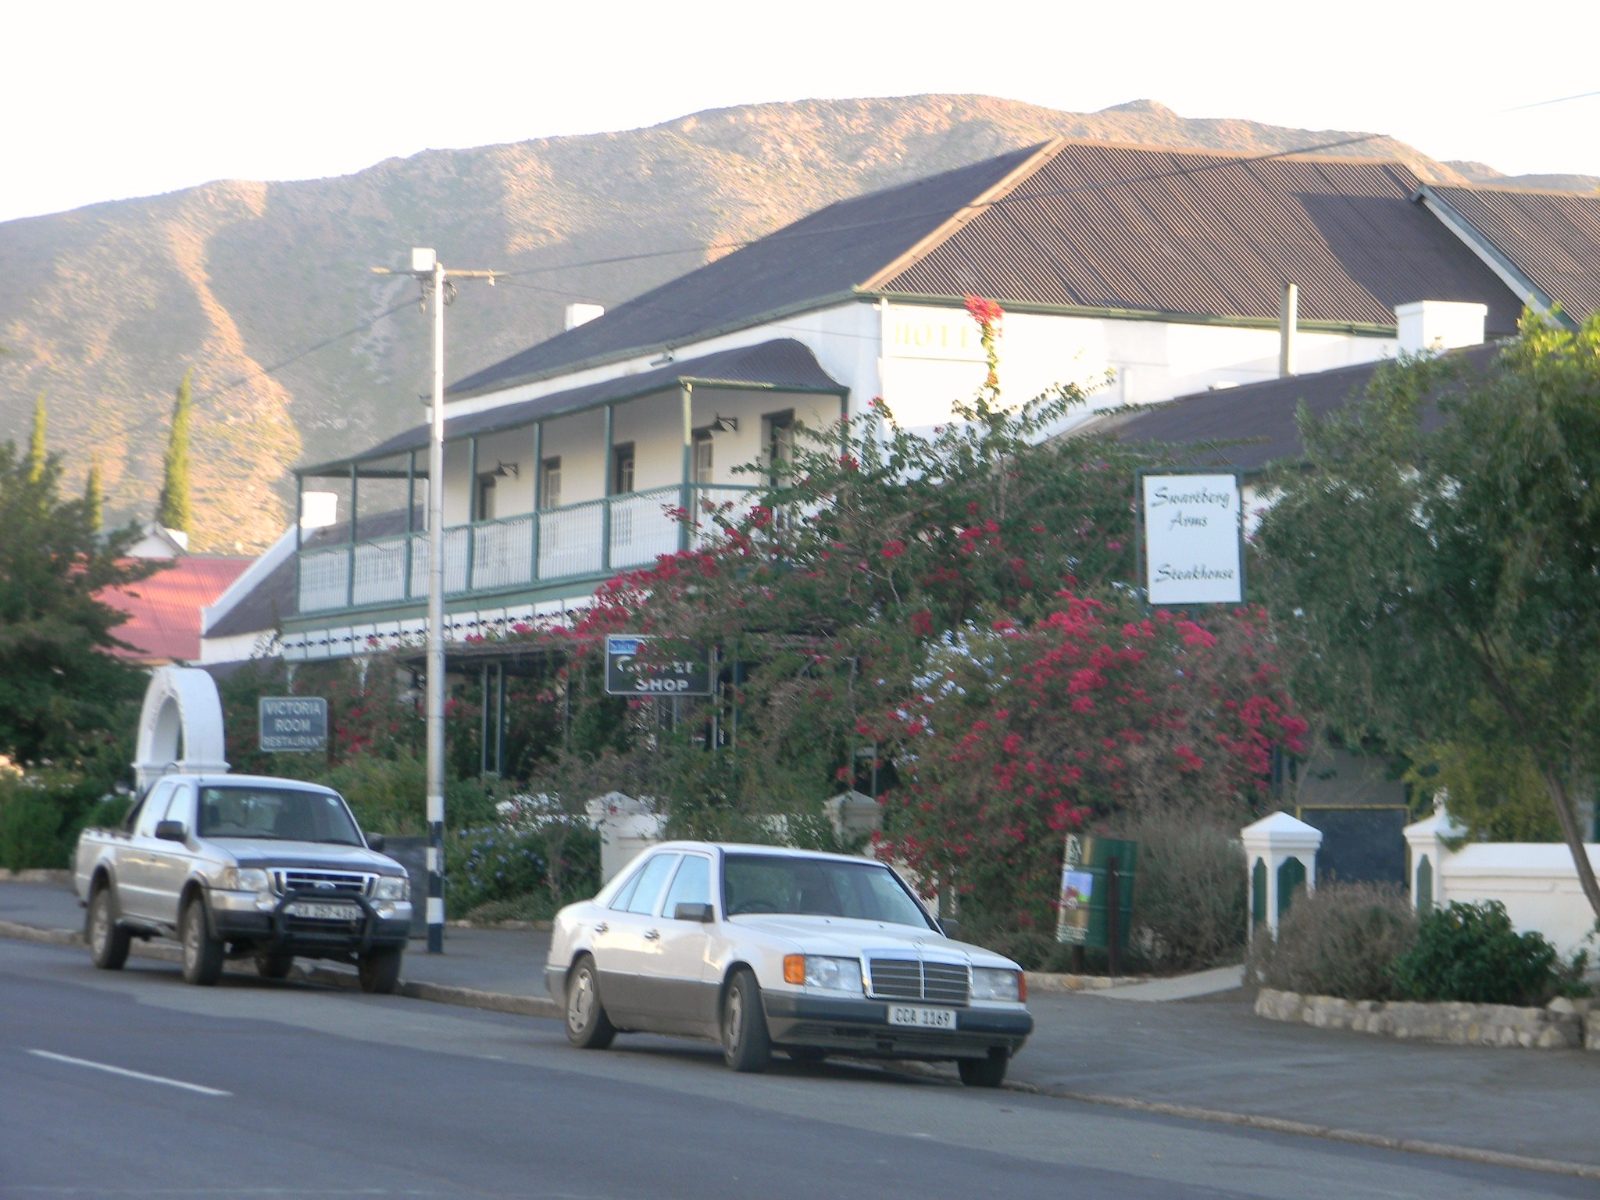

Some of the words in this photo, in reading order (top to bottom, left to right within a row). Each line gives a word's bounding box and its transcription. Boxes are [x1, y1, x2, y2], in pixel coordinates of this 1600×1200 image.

[1150, 486, 1231, 509] Swartberg
[1168, 510, 1208, 531] Arms
[1154, 563, 1234, 582] Steakhouse
[635, 678, 689, 692] SHOP
[266, 701, 321, 714] VICTORIA
[275, 718, 311, 732] ROOM
[895, 1008, 917, 1024] CCA
